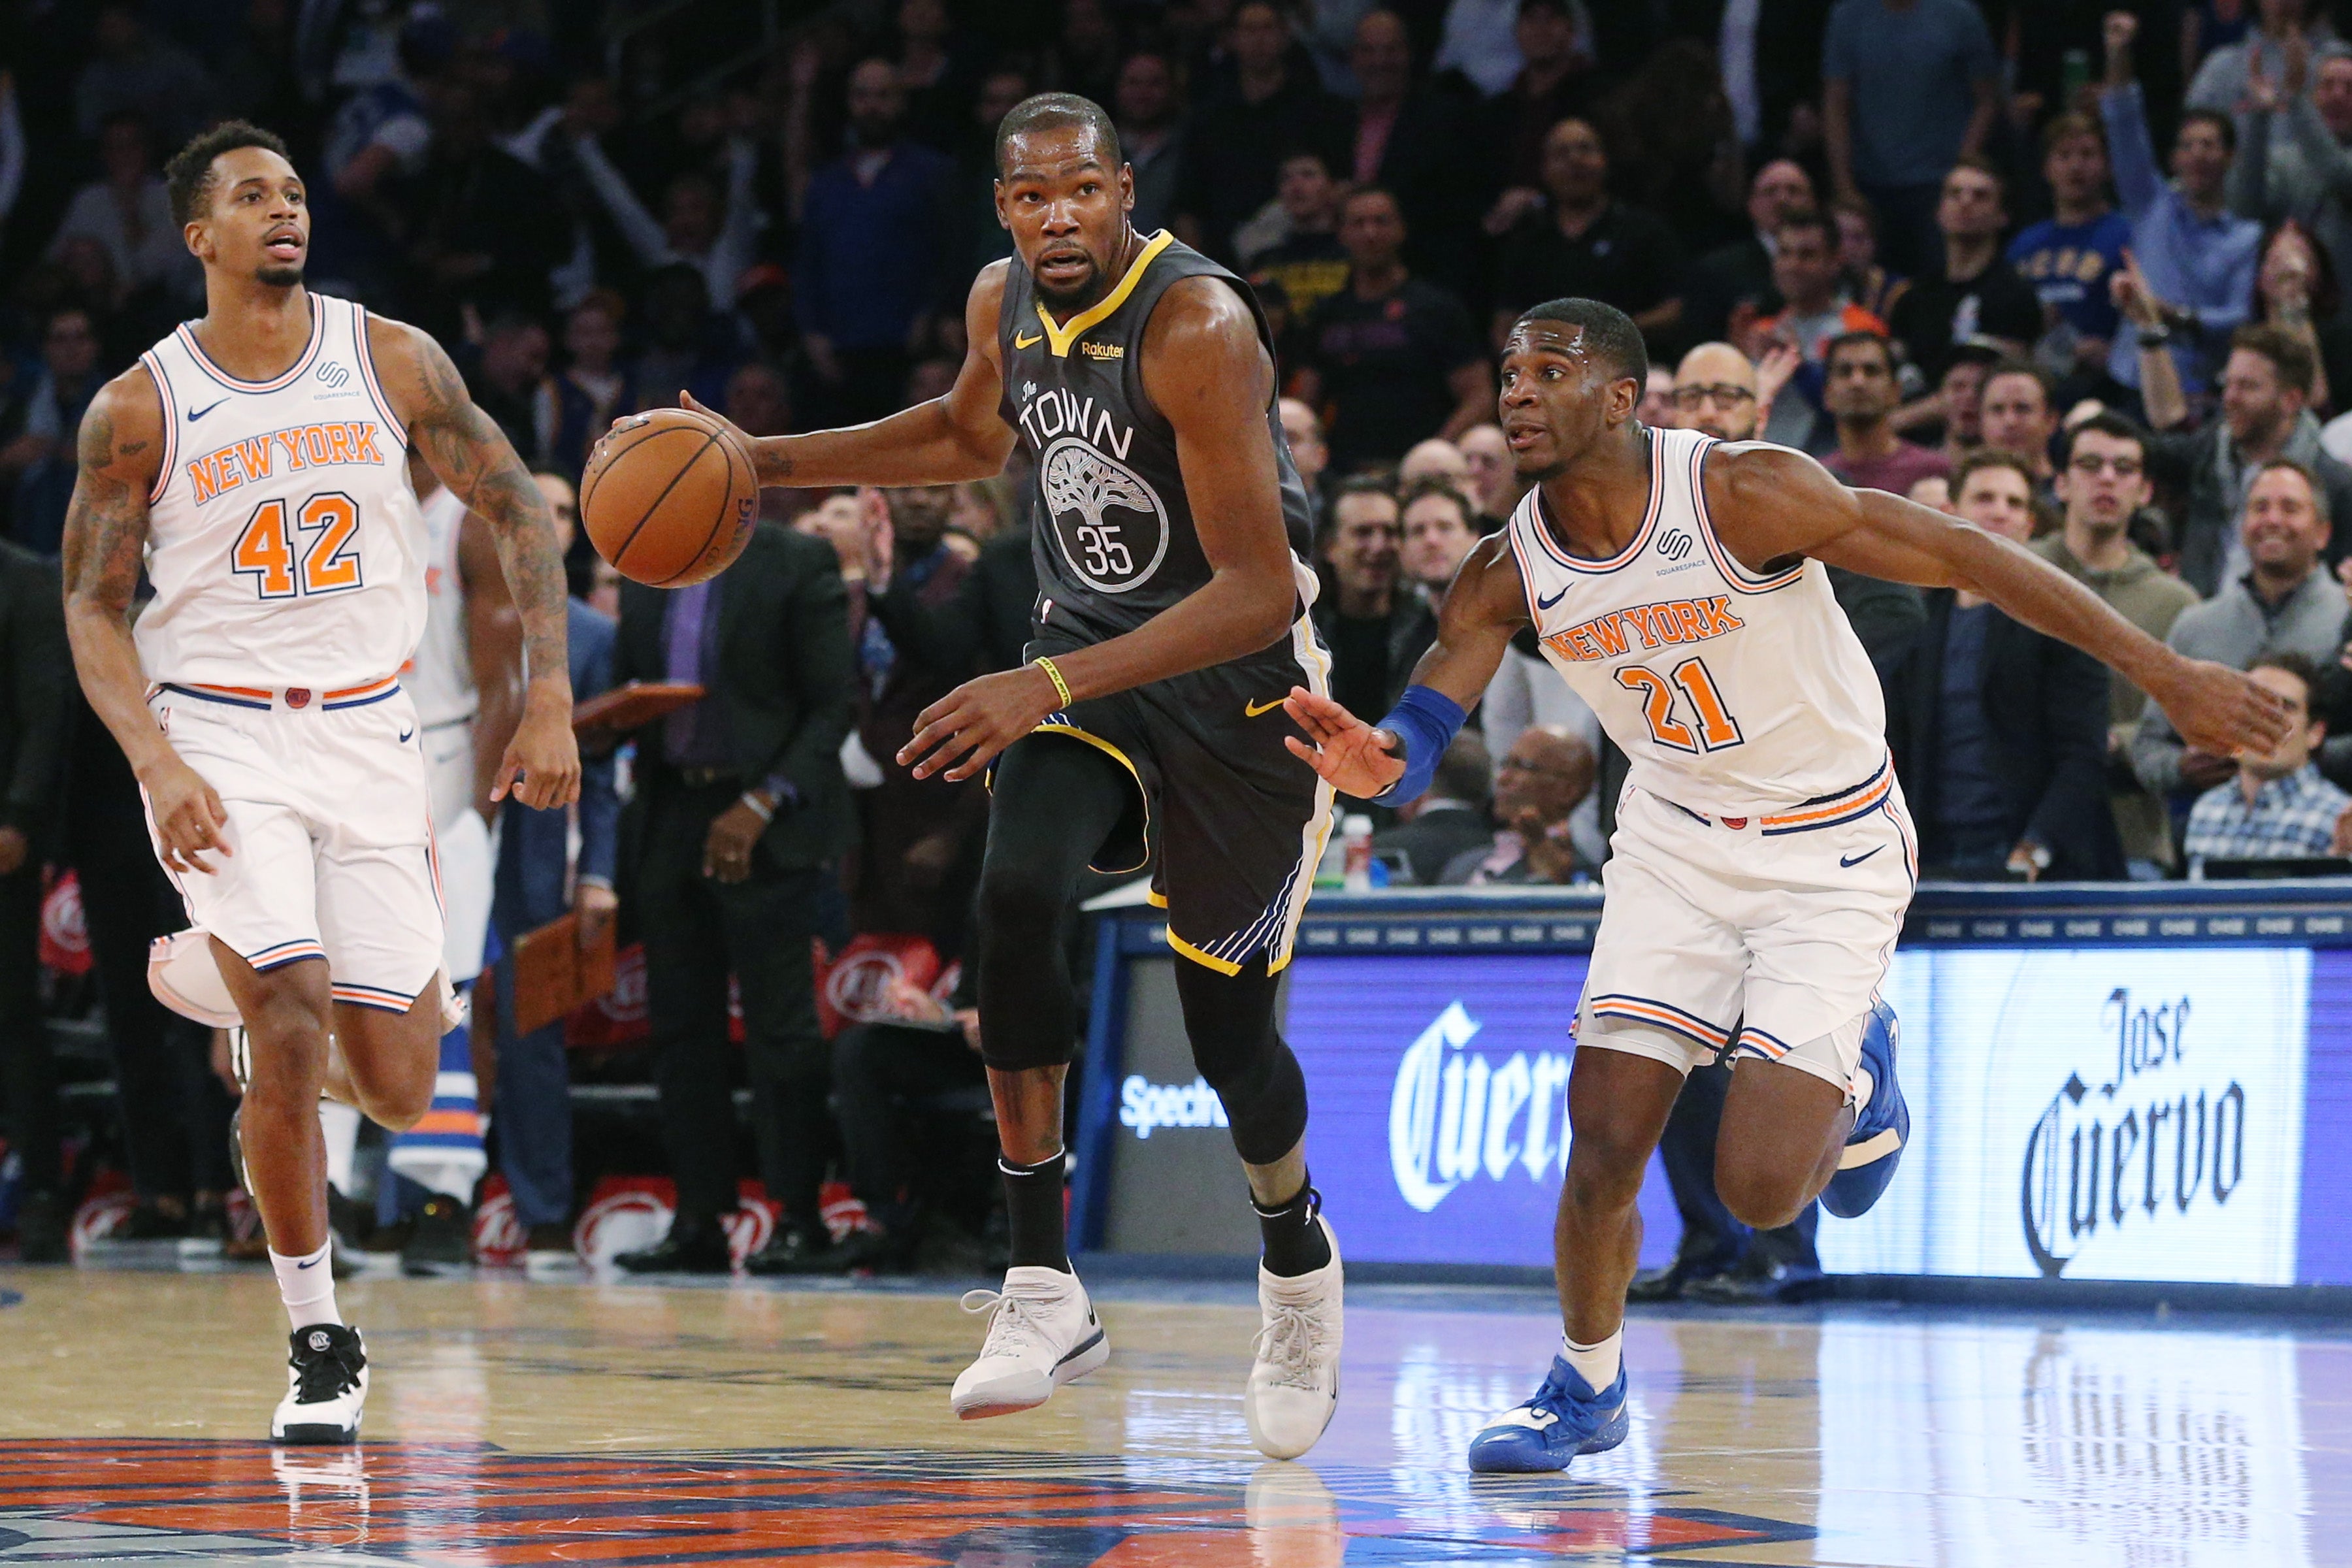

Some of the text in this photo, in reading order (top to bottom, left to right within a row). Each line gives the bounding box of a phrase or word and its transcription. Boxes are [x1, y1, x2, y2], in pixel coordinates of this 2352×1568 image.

[1082, 342, 1124, 359] Rakuten
[314, 391, 360, 400] SQUARESPACE
[1019, 387, 1134, 461] TOWN
[1022, 380, 1037, 402] The
[186, 421, 385, 506] NEW YORK
[231, 491, 363, 600] 42
[1077, 525, 1134, 575] 35
[1656, 559, 1707, 576] SQUARESPACE
[1539, 594, 1746, 662] NEW YORK
[1613, 656, 1745, 755] 21
[2101, 987, 2191, 1099] Jose
[1119, 1073, 1231, 1140] Spectr
[1388, 996, 1575, 1214] Cuer
[2022, 1070, 2245, 1279] Cuervo
